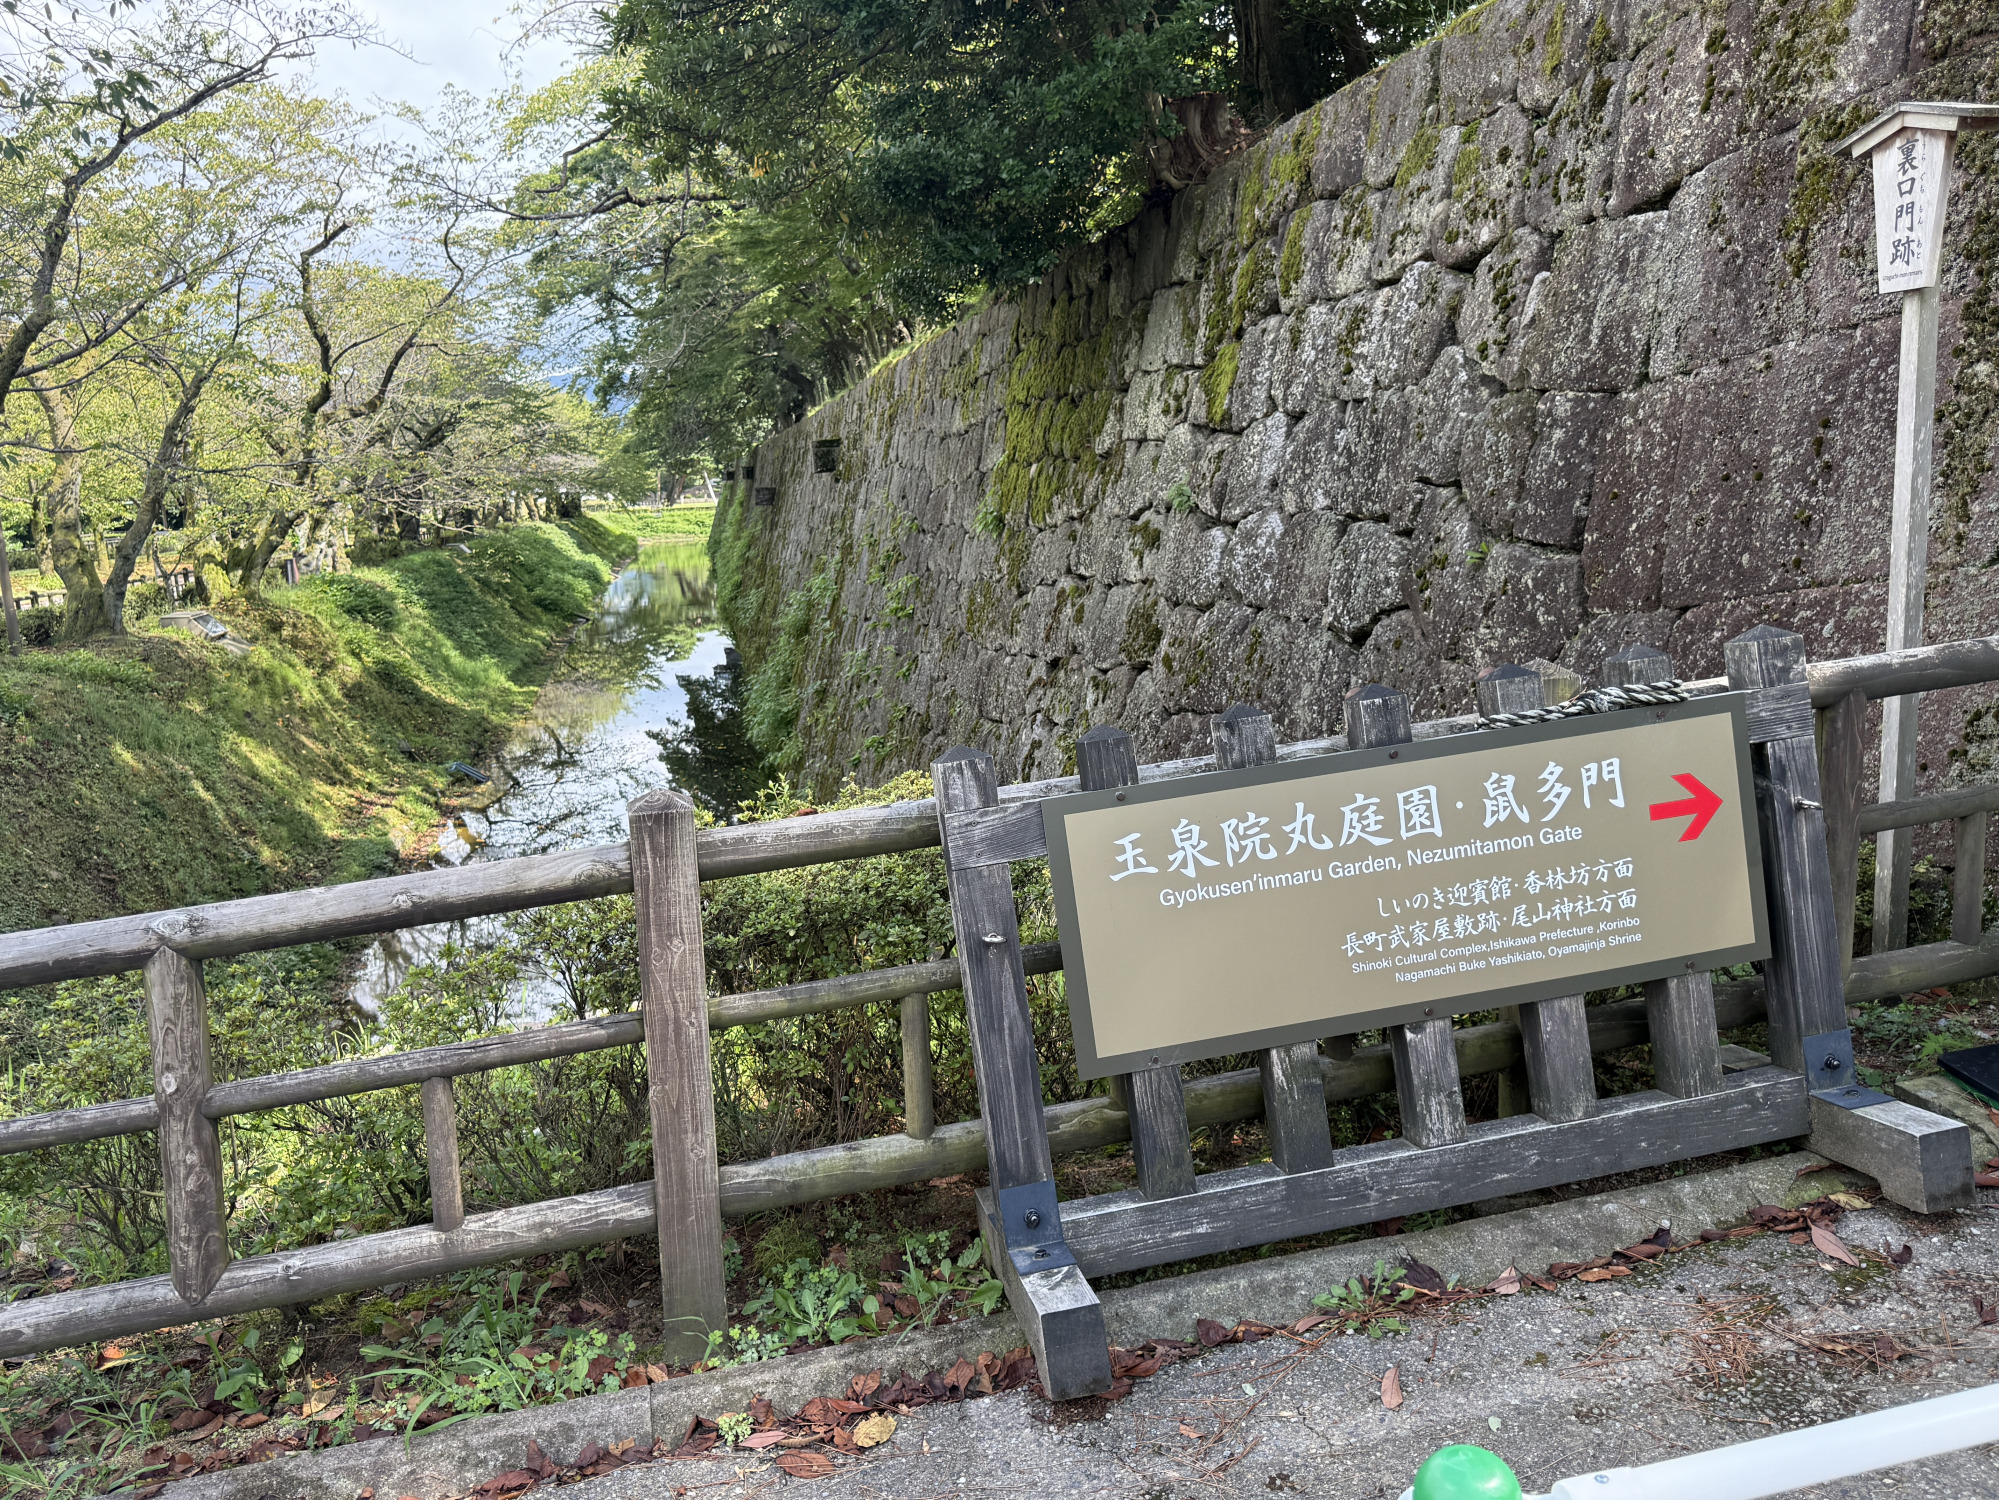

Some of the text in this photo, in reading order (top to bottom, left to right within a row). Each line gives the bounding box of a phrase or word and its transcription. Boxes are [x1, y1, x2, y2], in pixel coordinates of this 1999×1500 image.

[1889, 138, 1919, 267] 裏口門跡
[1159, 825, 1583, 909] Gyokusen'inmaru Garden, Nezumitamon Gate
[1351, 955, 1393, 975] Shinoki
[1394, 949, 1438, 967] Cultural
[1539, 924, 1594, 942] Prefecture
[1395, 932, 1642, 983] Nagamachi Buke Yashikiato, Oyamajinja Shrine
